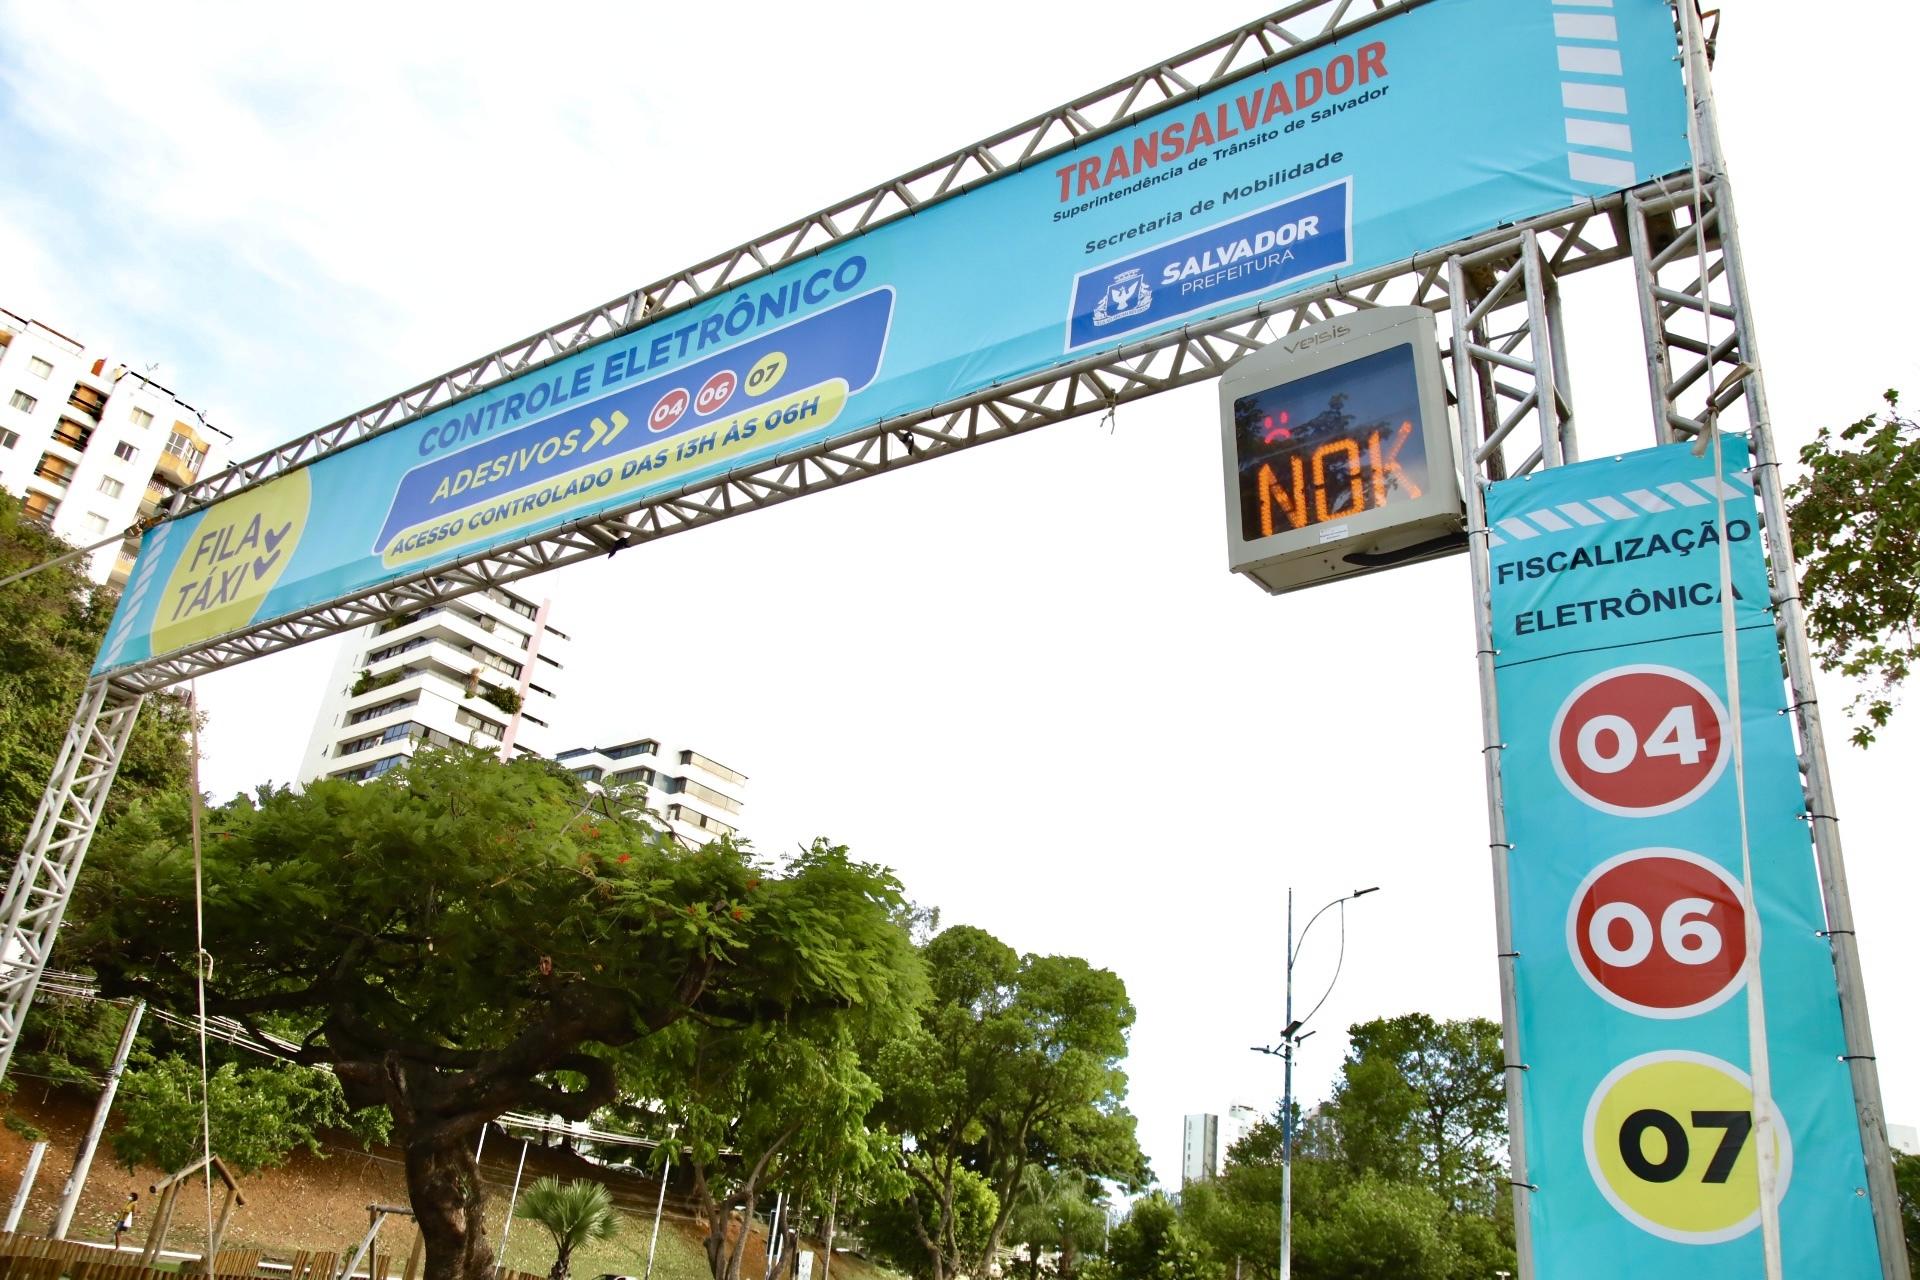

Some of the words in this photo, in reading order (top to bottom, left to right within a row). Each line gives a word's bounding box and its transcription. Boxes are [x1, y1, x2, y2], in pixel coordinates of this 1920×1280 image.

[1053, 166, 1183, 222] Superintendência
[1188, 155, 1208, 171] de
[1213, 128, 1278, 161] Trânsito
[1284, 118, 1305, 135] de
[1311, 84, 1389, 123] Salvador
[1056, 41, 1388, 202] TRANSALVADOR
[1085, 211, 1183, 254] Secretaria
[1190, 198, 1214, 216] de
[1222, 150, 1343, 205] Mobilidade
[1161, 216, 1319, 285] SALVADOR
[1181, 249, 1295, 295] PREFEITURA
[418, 365, 594, 457] CONTROLE
[601, 255, 868, 388] ELETRÔNICO
[429, 429, 582, 504] ADESIVOS
[654, 398, 684, 423] 04
[700, 381, 730, 406] 06
[749, 362, 780, 387] 07
[391, 518, 464, 556] ACESSO
[468, 468, 614, 530] CONTROLADO
[621, 449, 668, 481] DAS
[676, 431, 718, 462] 13H
[765, 396, 821, 431] 06H
[1257, 420, 1423, 537] NOK
[189, 512, 262, 573] FILA
[1498, 519, 1751, 584] FISCALIZAÇÃO
[171, 561, 249, 621] TÁXI
[1576, 705, 1707, 774] 04
[1588, 897, 1722, 968] 06
[1618, 1108, 1752, 1183] 07
